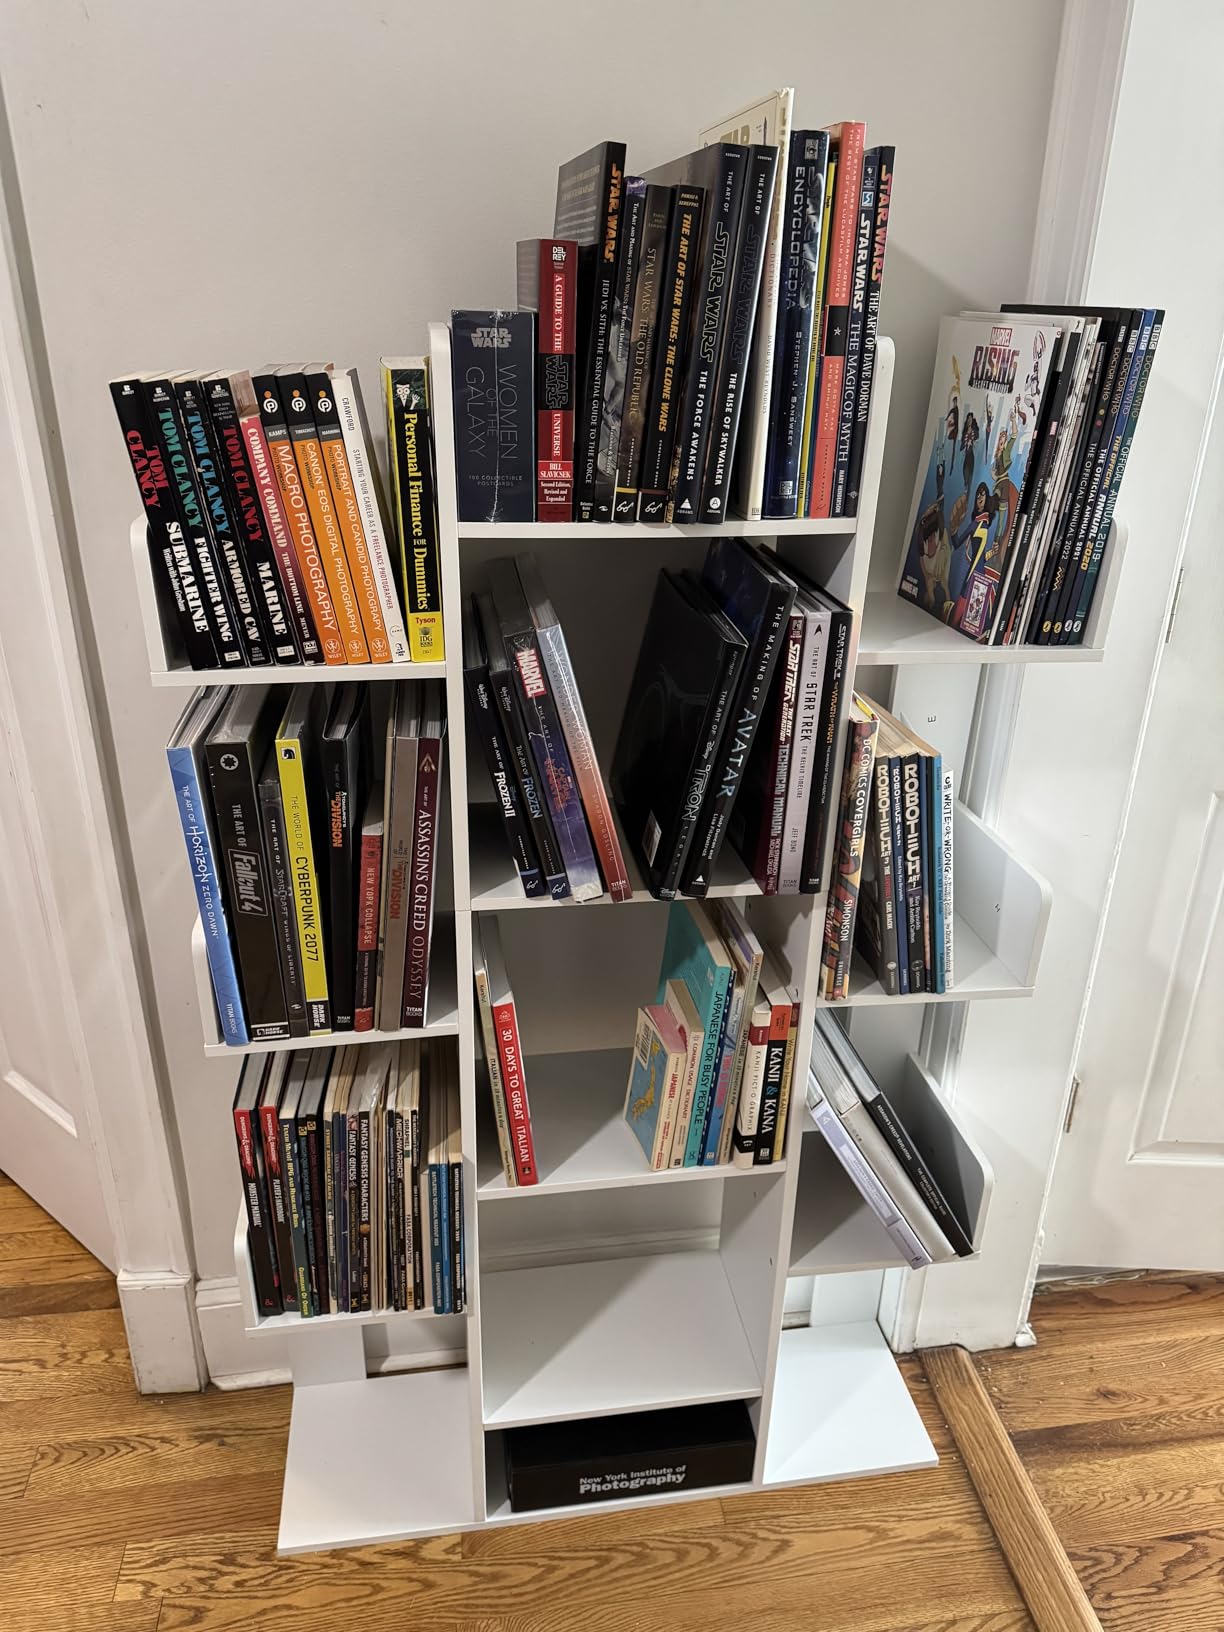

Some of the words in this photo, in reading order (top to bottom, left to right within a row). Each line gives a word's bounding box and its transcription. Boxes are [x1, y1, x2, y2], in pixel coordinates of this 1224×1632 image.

[608, 163, 622, 213] STAR
[875, 164, 892, 226] STAR
[604, 211, 620, 263] WARS
[682, 213, 691, 236] THE
[786, 166, 806, 310] ENCYCLOPEDIA
[857, 213, 871, 264] STAR
[679, 236, 689, 260] ART
[708, 222, 729, 292] STAR
[870, 226, 889, 283] WARS
[678, 262, 687, 273] OF
[673, 273, 685, 305] STAR
[853, 264, 866, 313] WARS
[867, 290, 880, 313] THE
[471, 327, 511, 338] STAR
[670, 309, 688, 341] WARS:
[700, 297, 721, 363] WARS
[849, 321, 861, 351] THE
[866, 314, 877, 334] ART
[1139, 326, 1151, 351] BBC
[471, 337, 511, 348] WARS
[667, 344, 677, 366] THE
[865, 338, 875, 351] OF
[699, 370, 708, 389] THE
[844, 355, 858, 403] MAGIC
[861, 353, 873, 378] DAVE
[970, 345, 1020, 383] RISING
[1131, 355, 1143, 391] DOCTOR
[662, 366, 674, 400] CLONE
[729, 373, 737, 389] THE
[341, 397, 355, 431] CRAWFORD
[466, 366, 486, 458] GALAXY
[499, 364, 518, 459] WOMEN
[658, 401, 669, 432] WARS
[694, 394, 705, 428] FORCE
[725, 391, 736, 413] RISE
[841, 403, 854, 420] OF
[856, 380, 870, 423] DORMAN
[1123, 391, 1134, 416] WHO
[722, 416, 731, 429] OF
[223, 425, 245, 469] TOM
[404, 412, 422, 477] Personal
[686, 432, 699, 480] AWAKENS
[838, 421, 851, 462] MYTH
[1113, 435, 1122, 451] THE
[126, 430, 161, 508] CLANCY
[145, 445, 169, 490] TOM
[306, 442, 322, 486] CANON
[714, 432, 729, 486] SKYWALKER
[1103, 453, 1117, 489] OFFICIAL
[247, 427, 270, 488] COMPANY
[262, 488, 287, 548] COMMAND
[318, 489, 330, 512] EOS
[233, 470, 263, 542] CLANCY
[408, 480, 424, 538] Finance
[1088, 493, 1106, 539] ANNUAL
[158, 407, 180, 453] TOM
[170, 454, 204, 528] CLANCY
[193, 537, 221, 609] FIGHTER
[213, 606, 233, 642] WING
[187, 411, 209, 454] TOM
[199, 459, 231, 534] CLANCY
[220, 539, 252, 615] ARMORED
[243, 615, 261, 642] CAV
[277, 445, 303, 509] MACRO
[296, 512, 336, 631] PHOTOGRAPHY
[322, 512, 340, 559] DIGITAL
[1080, 541, 1094, 571] 2020
[166, 521, 209, 632] SUBMARINE
[413, 547, 431, 610] Dummies
[256, 562, 286, 636] MARINE
[335, 557, 359, 635] PHOTOGRAPHY
[415, 617, 436, 625] Tyson
[772, 605, 784, 629] THE
[757, 635, 775, 681] MAKING
[788, 640, 800, 670] STAR
[750, 687, 760, 701] OF
[784, 670, 797, 703] TREK
[716, 709, 757, 797] AVATAR
[863, 738, 872, 753] DC
[774, 743, 789, 795] TECHNICAL
[857, 755, 870, 791] COMICS
[181, 785, 191, 799] THE
[185, 799, 194, 814] ART
[290, 795, 299, 810] THE
[188, 813, 196, 823] OF
[231, 803, 241, 821] THE
[292, 812, 302, 839] WORLD
[331, 800, 342, 847] DIVISION
[717, 814, 725, 827] Jody
[771, 797, 784, 837] MANUAL
[849, 788, 867, 858] COVERGIRLS
[233, 821, 244, 838] ART
[236, 837, 248, 847] OF
[297, 840, 304, 850] OF
[711, 827, 721, 849] Duncan
[188, 826, 211, 883] HORIZON
[414, 809, 432, 884] ASSASSIN'S
[233, 853, 262, 900] Fallout
[366, 867, 375, 884] NEW
[201, 884, 213, 910] ZERO
[240, 899, 263, 912] 4
[295, 857, 315, 930] CYBERPUNK
[366, 885, 375, 906] YORK
[413, 883, 427, 932] CREED
[207, 910, 219, 937] DAWN
[363, 908, 374, 944] COLLAPSE
[840, 899, 853, 942] SIMONSON
[303, 932, 319, 962] 2077
[408, 935, 425, 999] ODYSSEY
[836, 960, 844, 987] UNIVERSE
[312, 1005, 320, 1027] HORSE
[502, 1029, 513, 1041] 30
[504, 1046, 517, 1071] DAYS
[769, 1047, 783, 1082] KANJI
[509, 1074, 519, 1087] TO
[668, 1073, 679, 1099] JAPANESE
[766, 1086, 776, 1095] &
[511, 1091, 524, 1121] GREAT
[761, 1099, 776, 1134] KANA
[348, 1130, 357, 1156] FANTASY
[360, 1119, 368, 1149] FANTASY
[395, 1118, 403, 1179] MECHWARRIOR
[516, 1126, 530, 1163] ITALIAN
[349, 1157, 357, 1181] GENESIS
[361, 1179, 369, 1221] CHARACTERS
[579, 1473, 686, 1494] Photography
[605, 1473, 628, 1481] York
[630, 1468, 673, 1478] Institute
